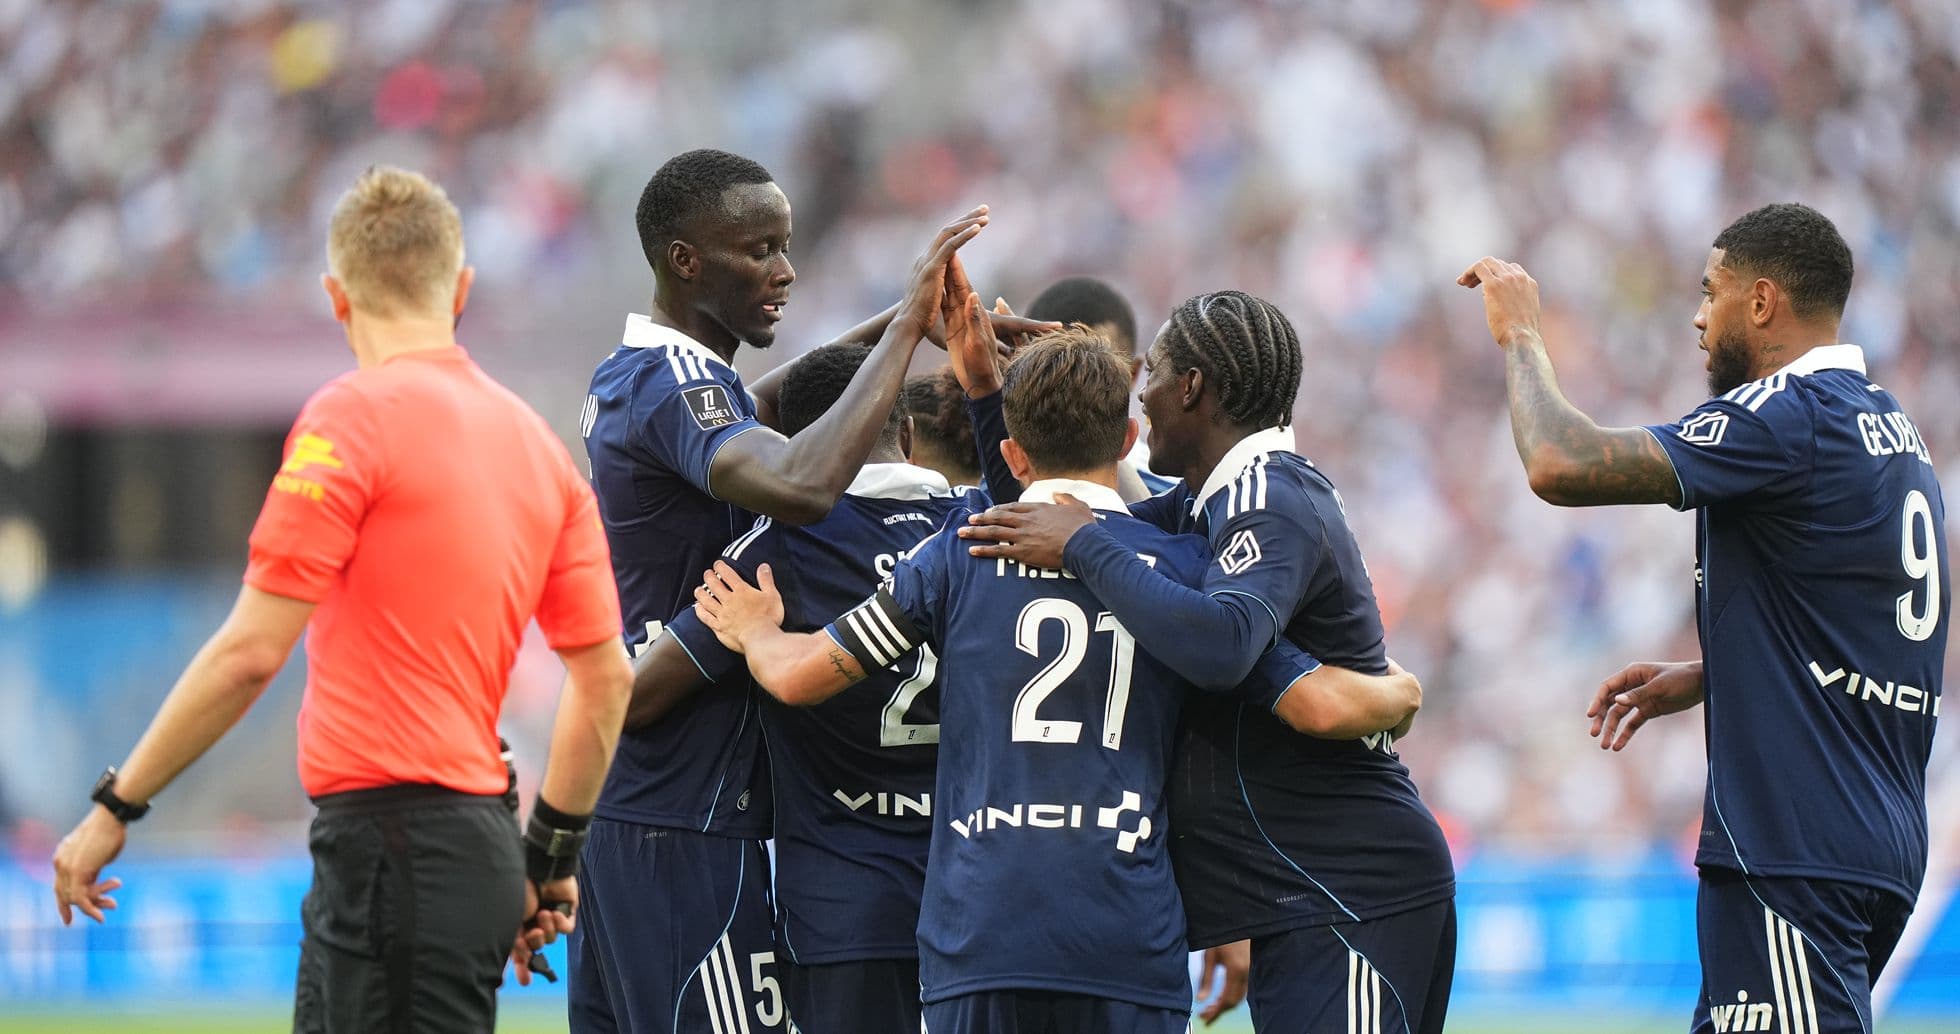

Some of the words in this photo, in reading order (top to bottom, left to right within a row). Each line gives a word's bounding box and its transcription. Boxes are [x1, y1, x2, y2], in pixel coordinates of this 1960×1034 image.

[698, 410, 725, 421] LIGUE
[1896, 489, 1940, 641] 9
[1011, 597, 1136, 751] 21
[1808, 660, 1929, 716] VINCI
[833, 788, 931, 816] VIN
[950, 804, 1082, 839] VINCI
[750, 951, 784, 1028] 5
[1709, 989, 1773, 1034] win
